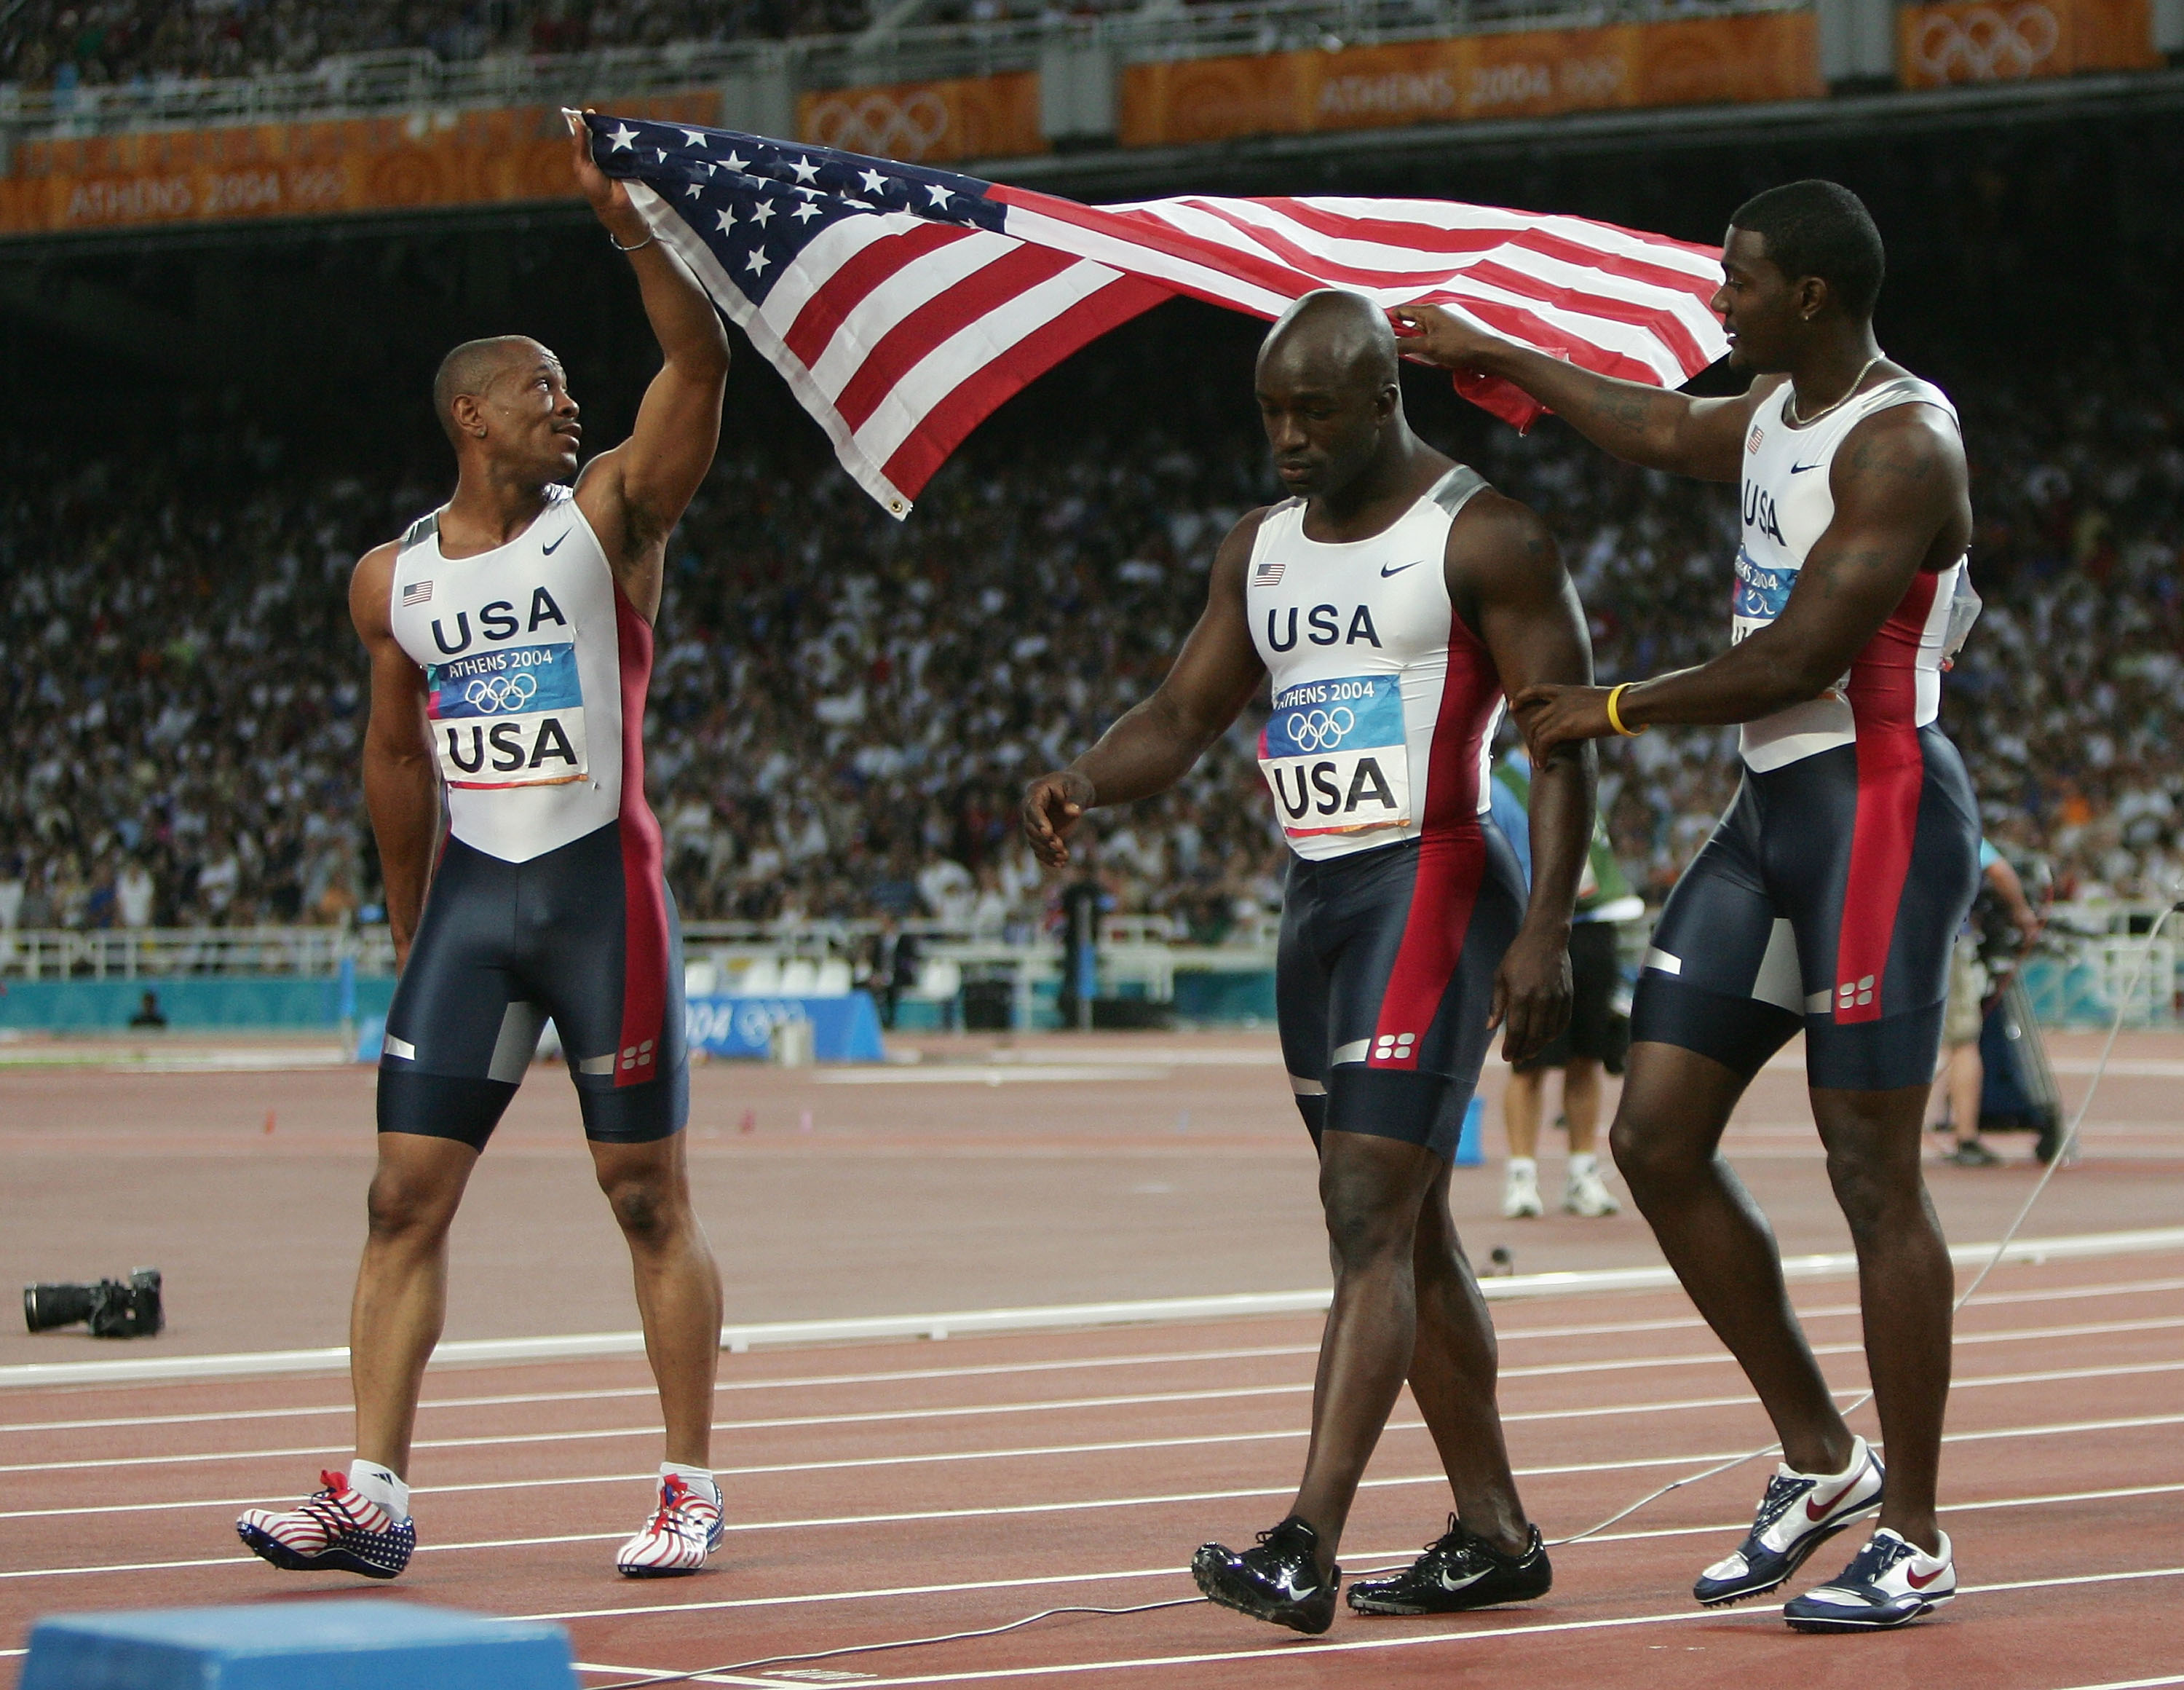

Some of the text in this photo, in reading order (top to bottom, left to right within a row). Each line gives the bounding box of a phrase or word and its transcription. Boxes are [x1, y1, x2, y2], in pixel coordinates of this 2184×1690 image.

[1318, 63, 1551, 113] ATHENS 2004
[68, 172, 280, 217] ATHENS 2004
[1744, 478, 1787, 547] USA
[431, 585, 567, 655] USA
[1267, 604, 1383, 652] USA
[448, 649, 553, 678] ATHENS 2004
[1331, 681, 1374, 701] 2004
[446, 718, 578, 773] USA
[1274, 757, 1398, 819] USA
